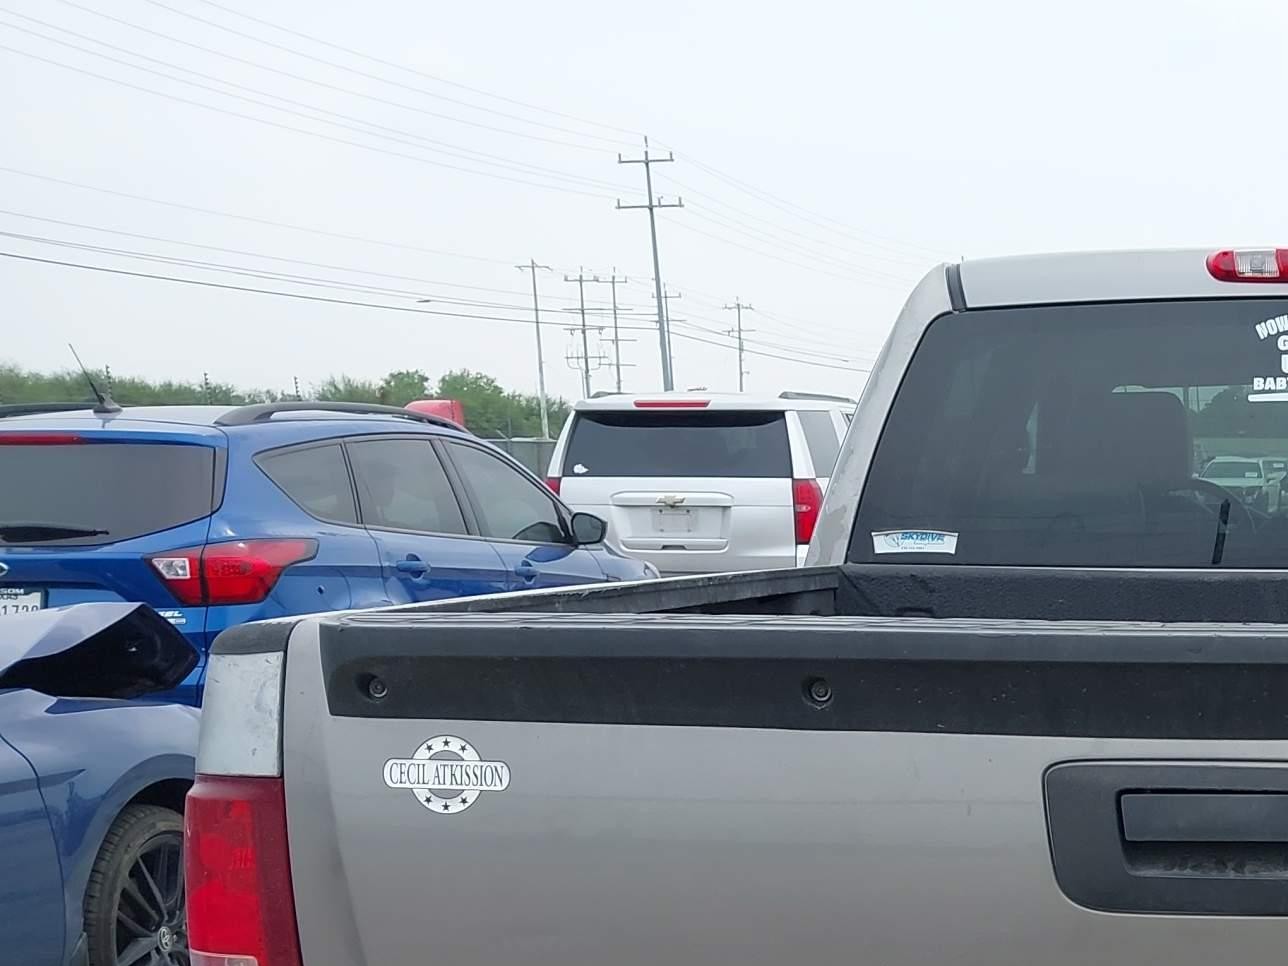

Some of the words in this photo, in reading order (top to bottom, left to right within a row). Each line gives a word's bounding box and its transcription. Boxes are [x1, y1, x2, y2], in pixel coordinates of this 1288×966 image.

[1255, 314, 1288, 340] NOW
[901, 531, 945, 542] SKYDIVE
[389, 762, 429, 785] CECIL
[432, 764, 505, 787] ATKISSION
